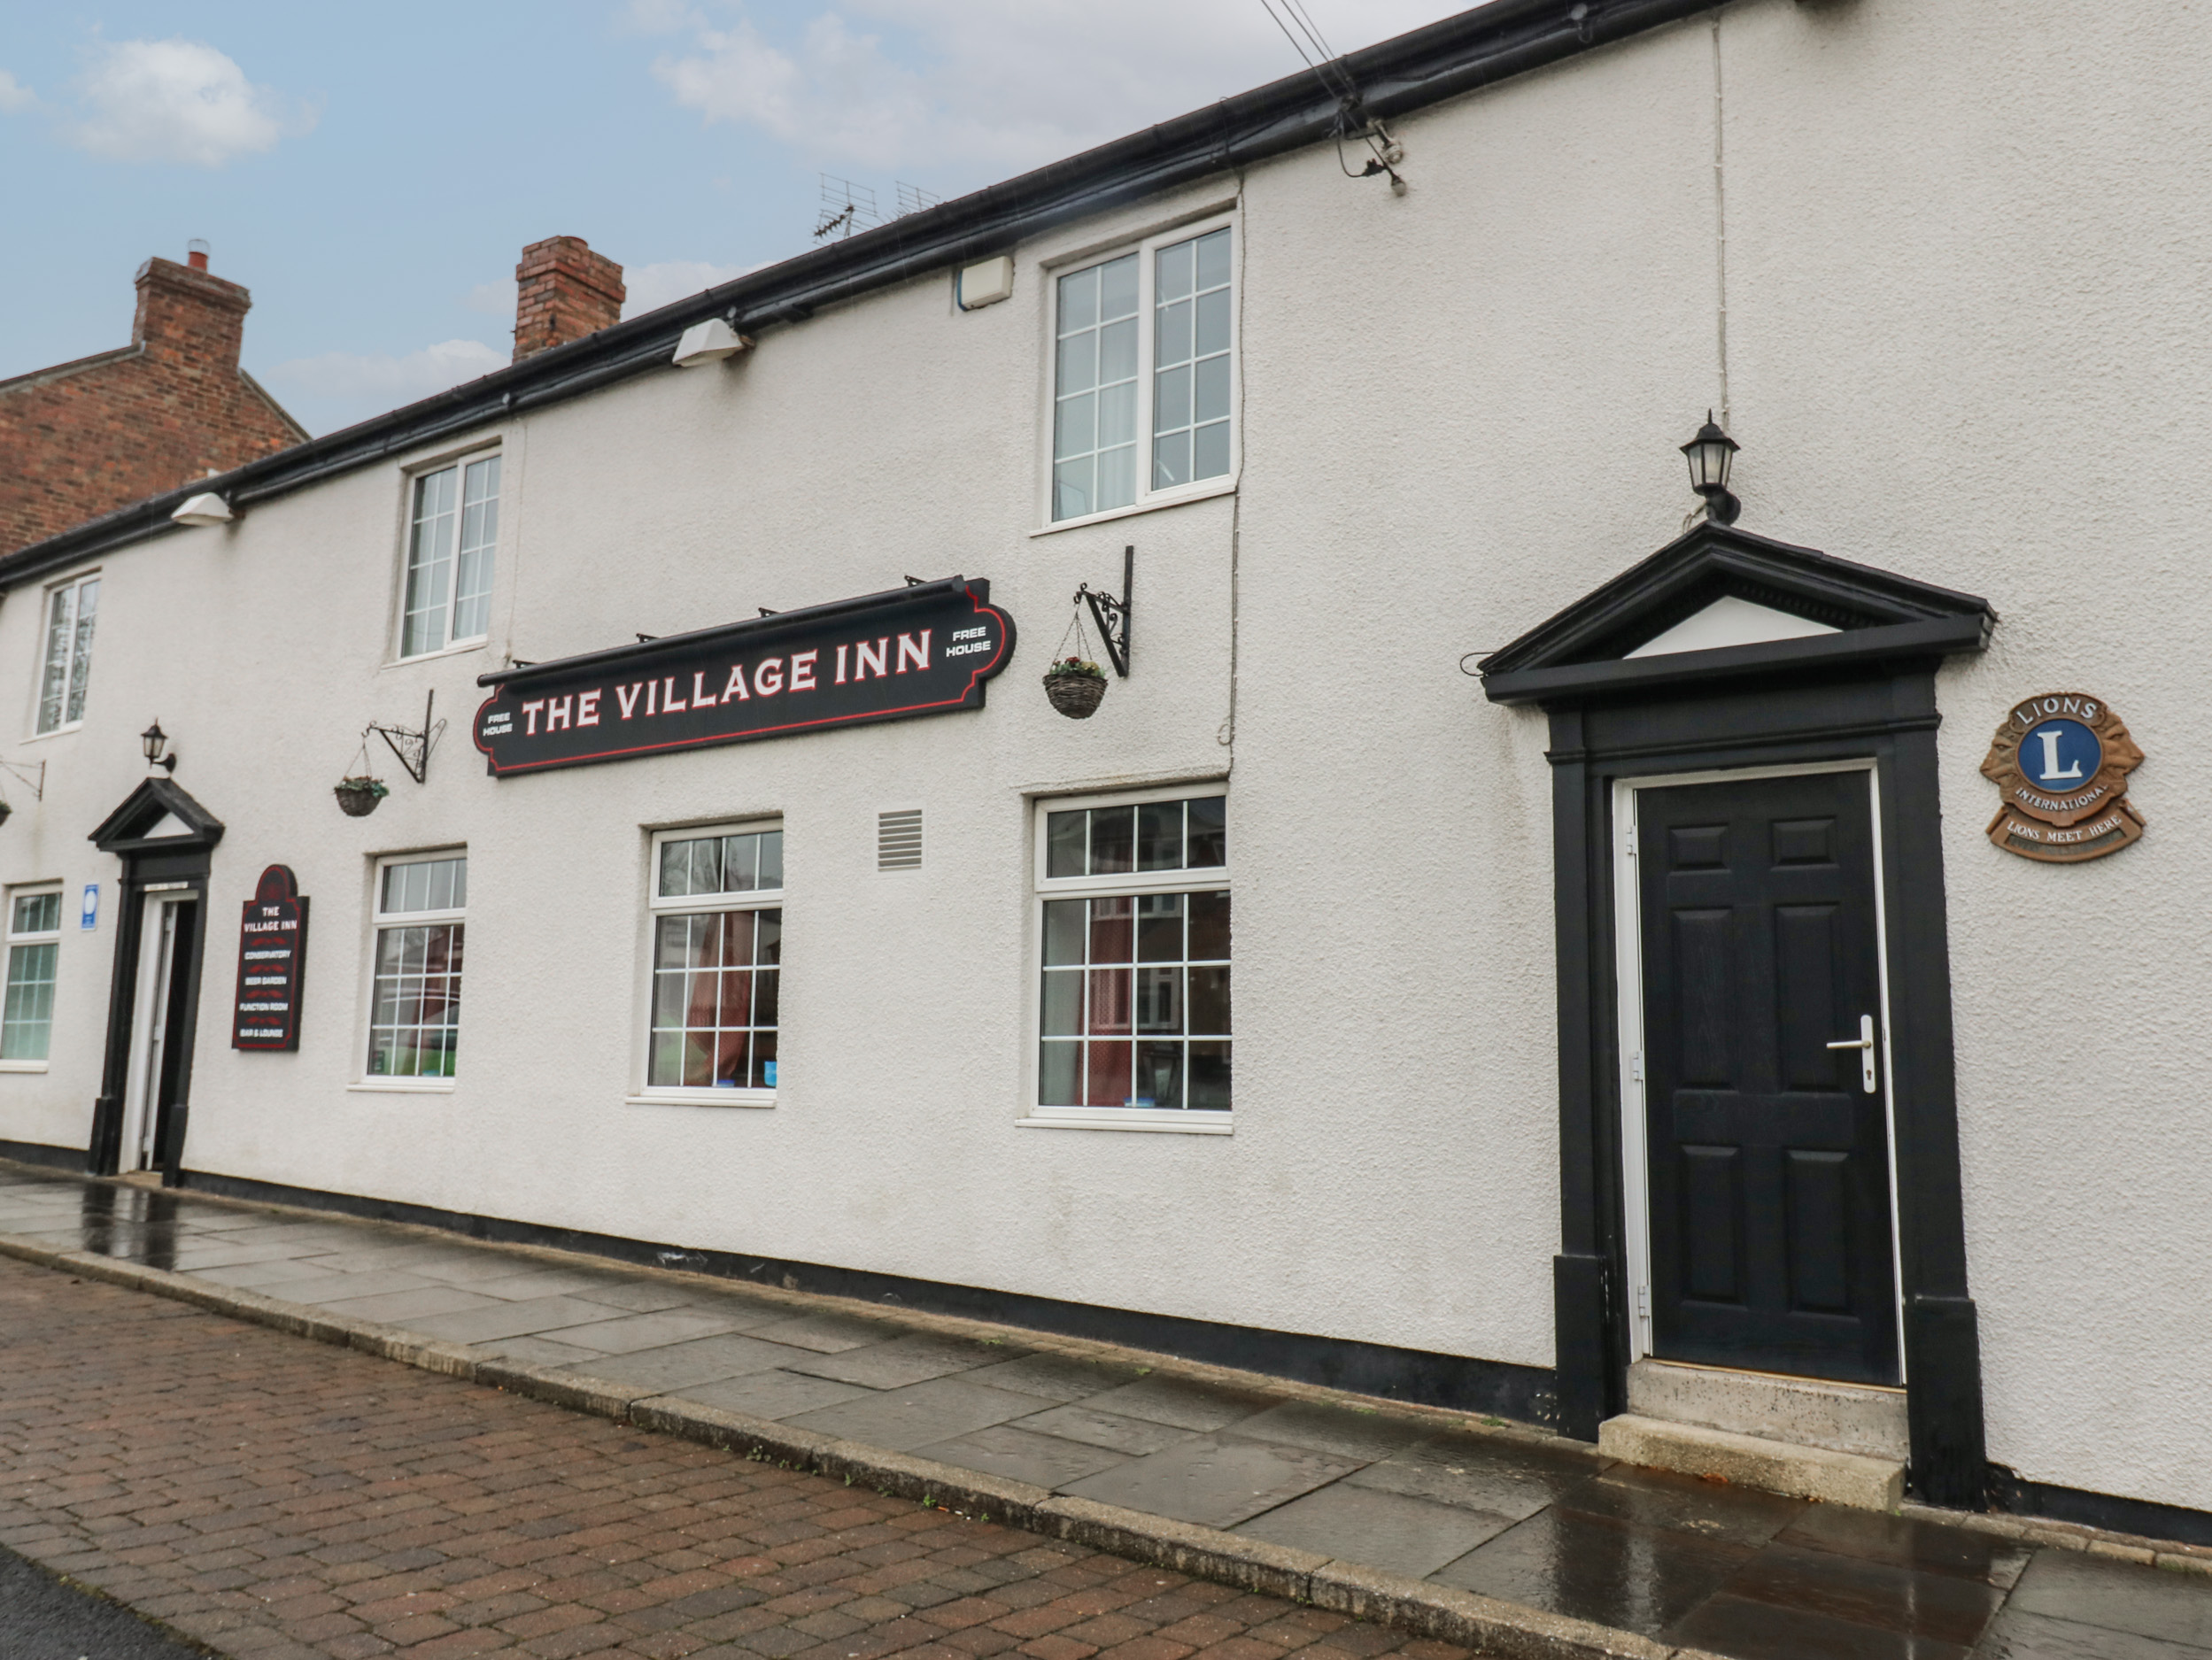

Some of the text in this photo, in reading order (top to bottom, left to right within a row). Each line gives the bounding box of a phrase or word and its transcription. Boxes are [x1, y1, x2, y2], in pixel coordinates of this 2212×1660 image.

[953, 626, 986, 641] FREE
[946, 640, 991, 657] HOUSE
[522, 629, 932, 737] THE VILLAGE INN
[487, 712, 511, 724] FREE
[2016, 698, 2097, 725] LIONS
[483, 723, 513, 737] HOUSE
[2037, 730, 2083, 780] L
[2015, 784, 2109, 811] INTERNATIONAL
[2007, 815, 2123, 842] LIONS MEET HERE
[262, 907, 280, 917] THE
[244, 919, 298, 932] VILLAGE INN
[239, 1002, 289, 1011] FUNCTION ROOM
